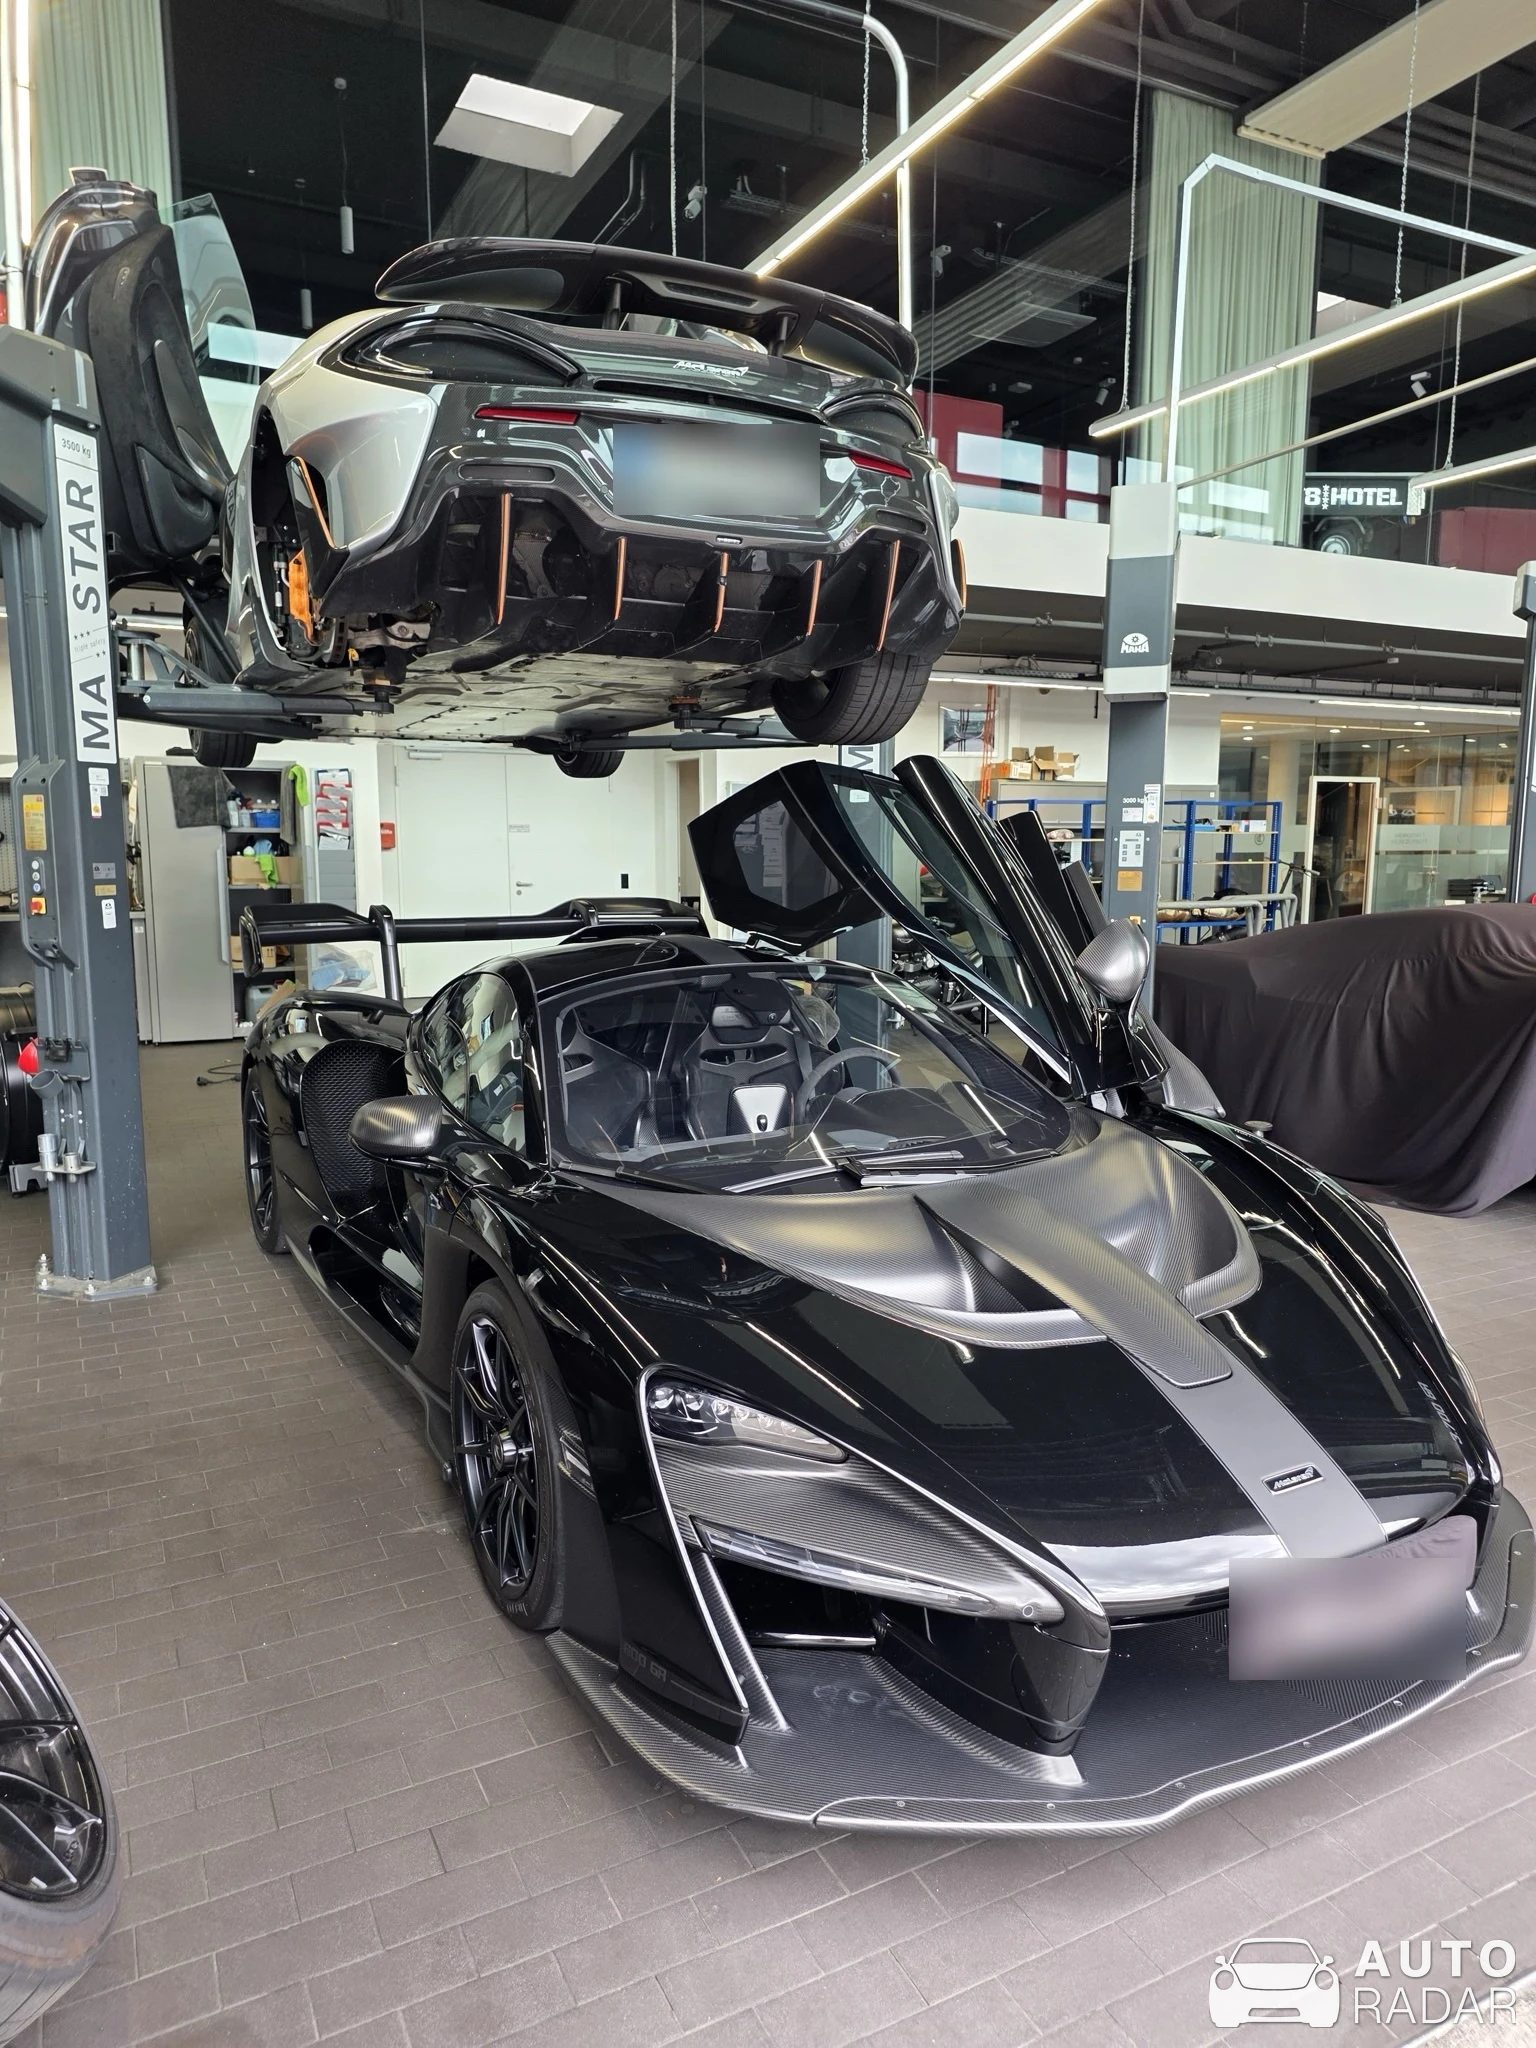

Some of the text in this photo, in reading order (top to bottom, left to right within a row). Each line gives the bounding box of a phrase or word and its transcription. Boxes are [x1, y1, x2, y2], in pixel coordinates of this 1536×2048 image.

[61, 438, 92, 459] 3500 kg
[1303, 487, 1403, 506] 8 HOTEL
[65, 479, 101, 615] STAR
[1120, 640, 1150, 654] MAHA
[79, 674, 110, 750] MA
